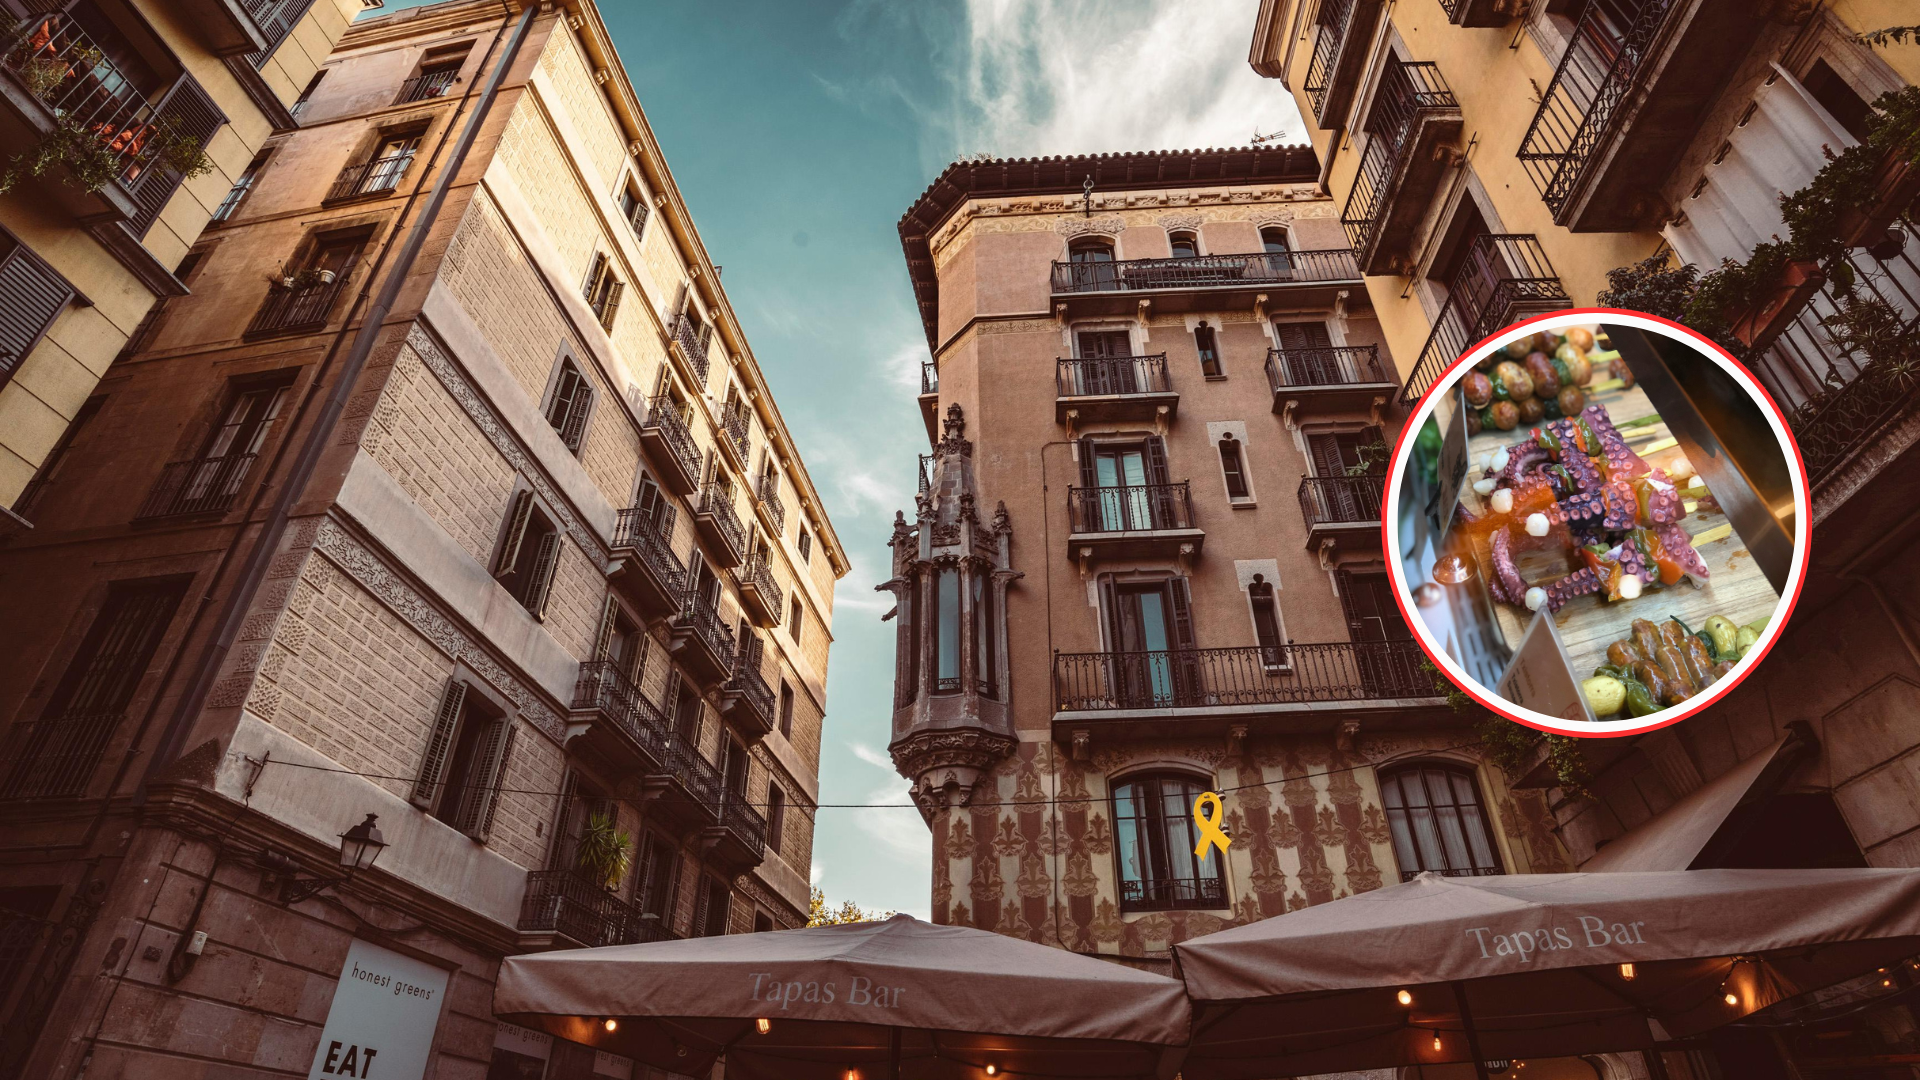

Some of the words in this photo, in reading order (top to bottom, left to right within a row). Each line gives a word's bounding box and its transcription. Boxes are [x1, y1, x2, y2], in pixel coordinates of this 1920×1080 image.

[1465, 927, 1573, 963] Tapas
[1576, 915, 1647, 948] Bar
[351, 961, 391, 988] honest
[394, 981, 431, 1001] greens
[748, 973, 836, 1011] Tapas
[846, 976, 906, 1009] Bar
[498, 1023, 520, 1037] onest
[522, 1031, 549, 1045] greens
[322, 1040, 378, 1080] EAT
